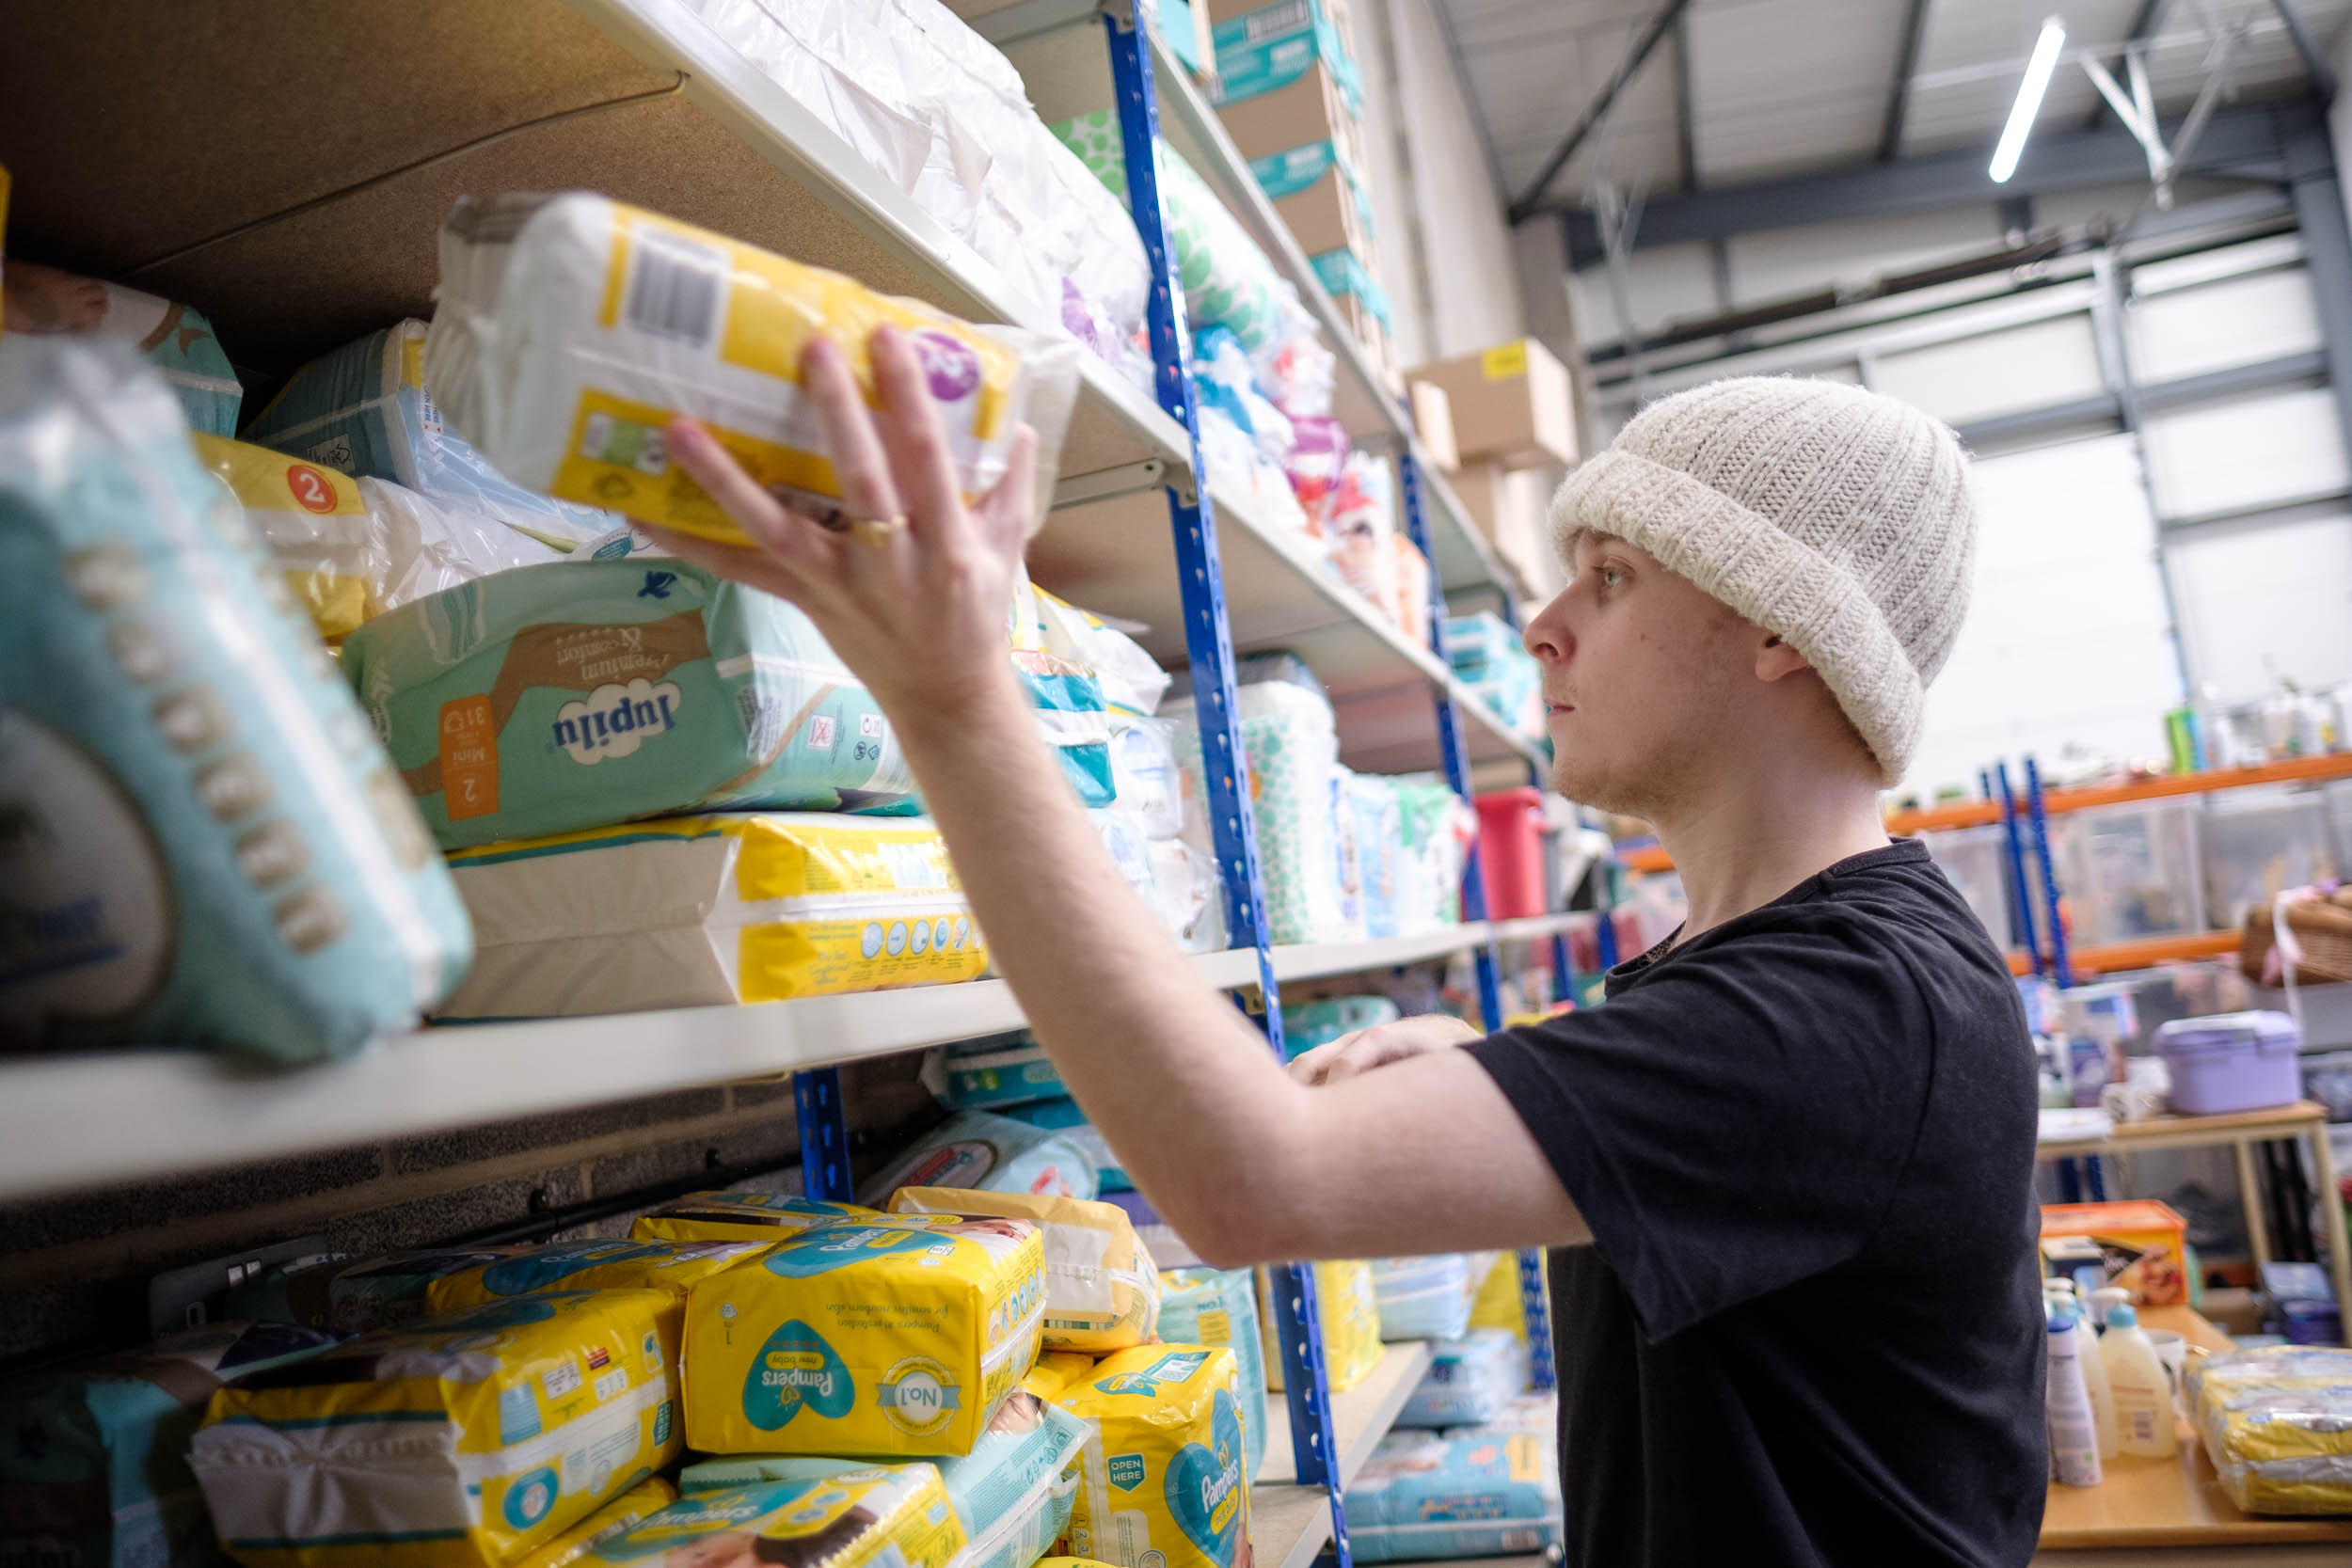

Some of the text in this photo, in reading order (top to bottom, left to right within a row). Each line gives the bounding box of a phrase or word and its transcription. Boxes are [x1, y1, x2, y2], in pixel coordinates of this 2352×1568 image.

[298, 473, 325, 502] 2
[580, 653, 670, 680] Premium
[466, 706, 485, 725] 31
[551, 694, 676, 750] lupilu
[453, 748, 485, 766] Mini
[463, 778, 475, 802] 2
[772, 1354, 797, 1367] baby
[761, 1368, 833, 1397] Pampers
[900, 1387, 937, 1406] No.1
[1111, 1459, 1141, 1470] OPEN
[1113, 1470, 1142, 1481] HERE
[1201, 1459, 1239, 1513] Pampers
